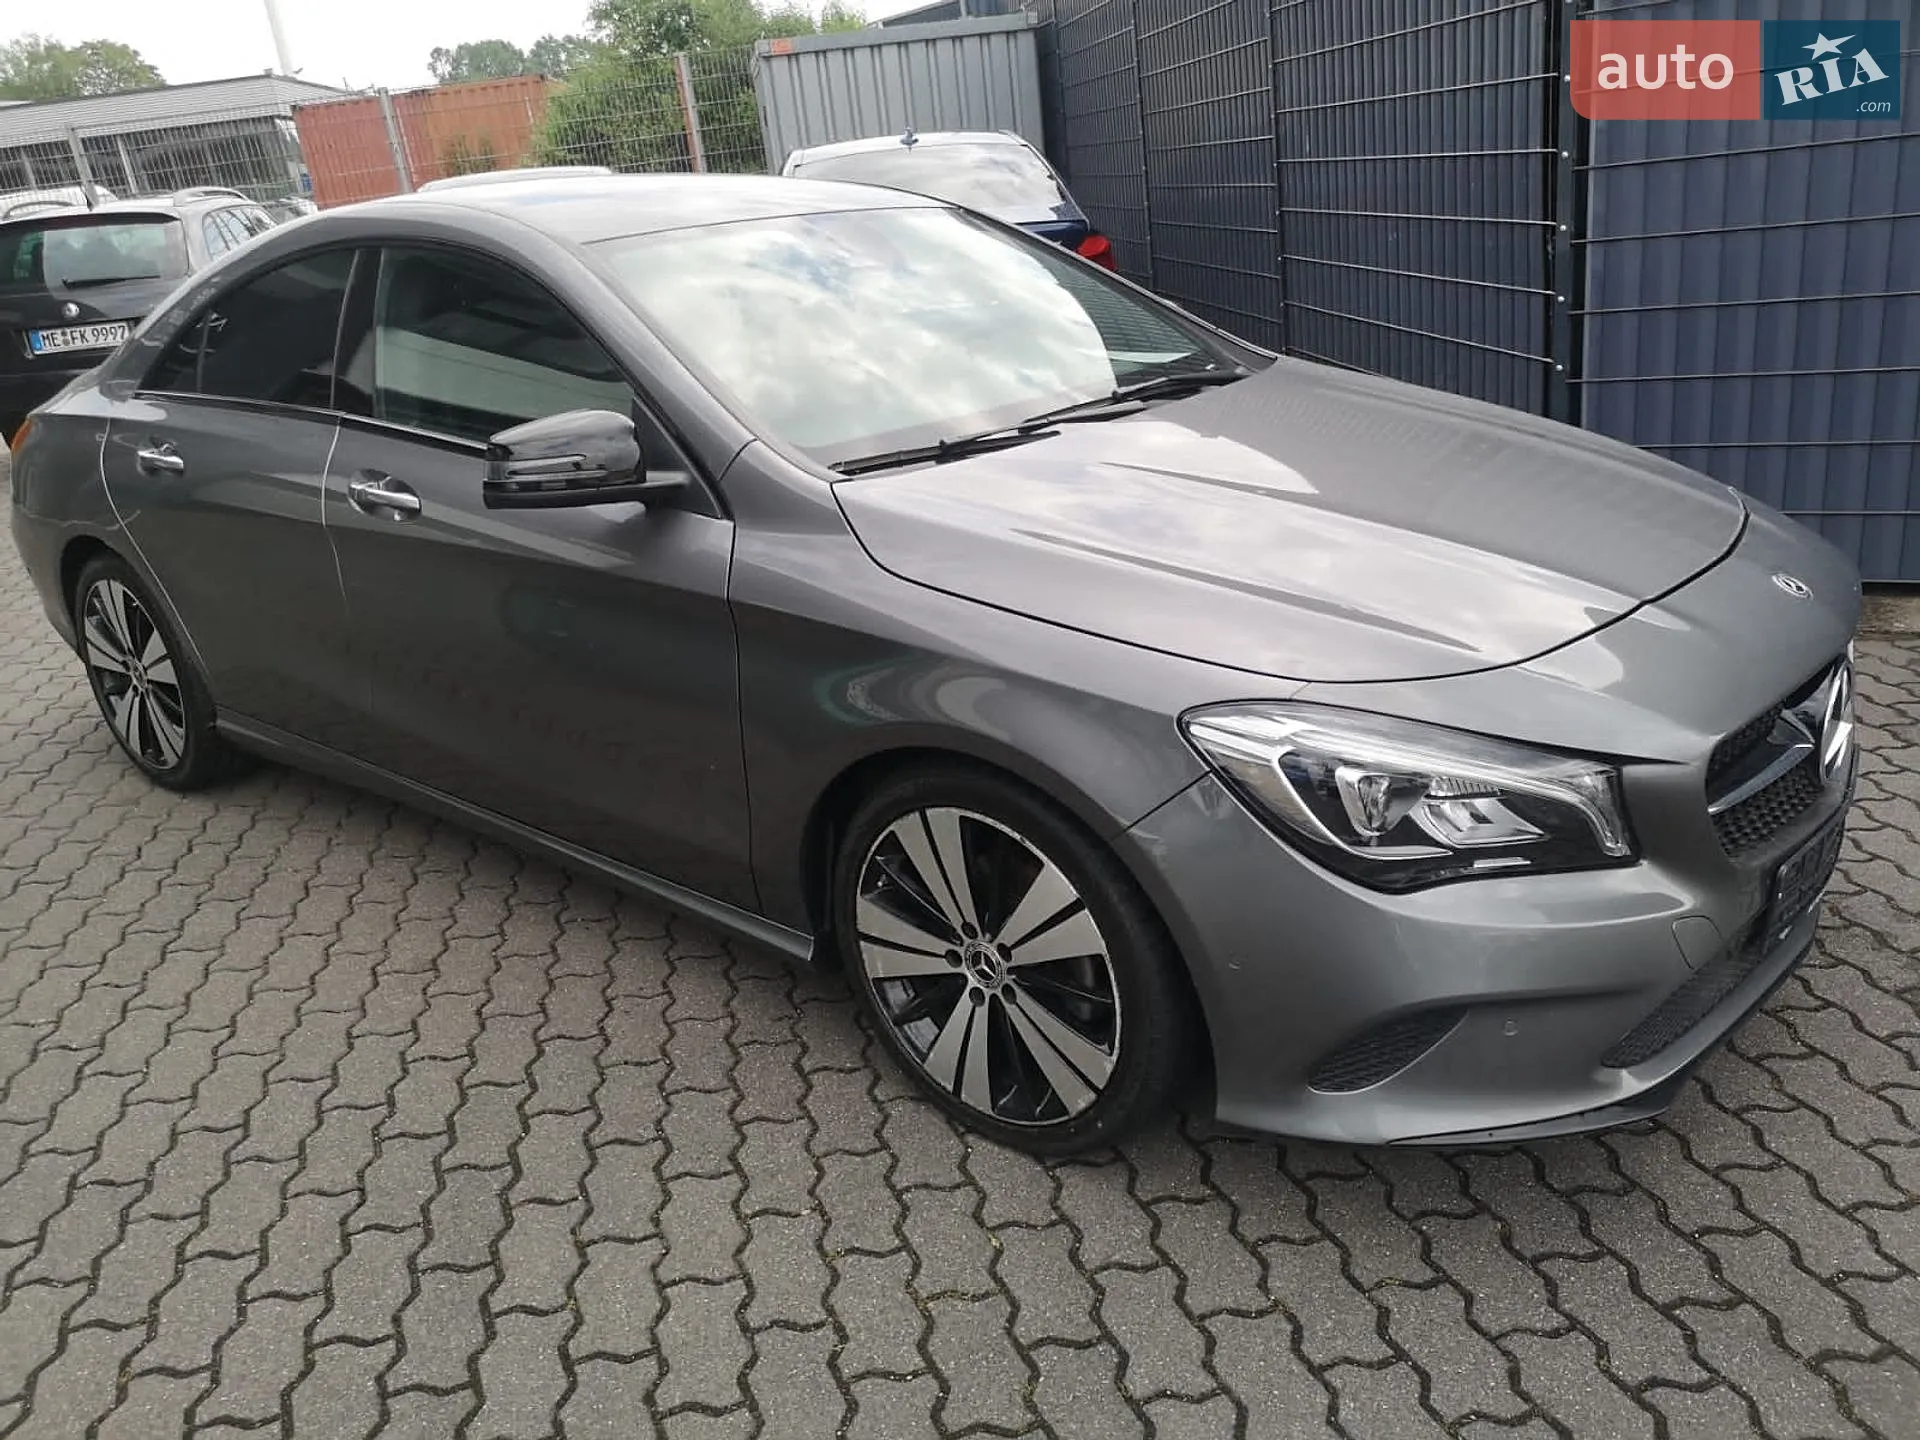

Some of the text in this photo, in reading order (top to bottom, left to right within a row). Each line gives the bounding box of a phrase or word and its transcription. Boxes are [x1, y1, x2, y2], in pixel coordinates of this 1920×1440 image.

[41, 325, 126, 347] ME FK 9997
